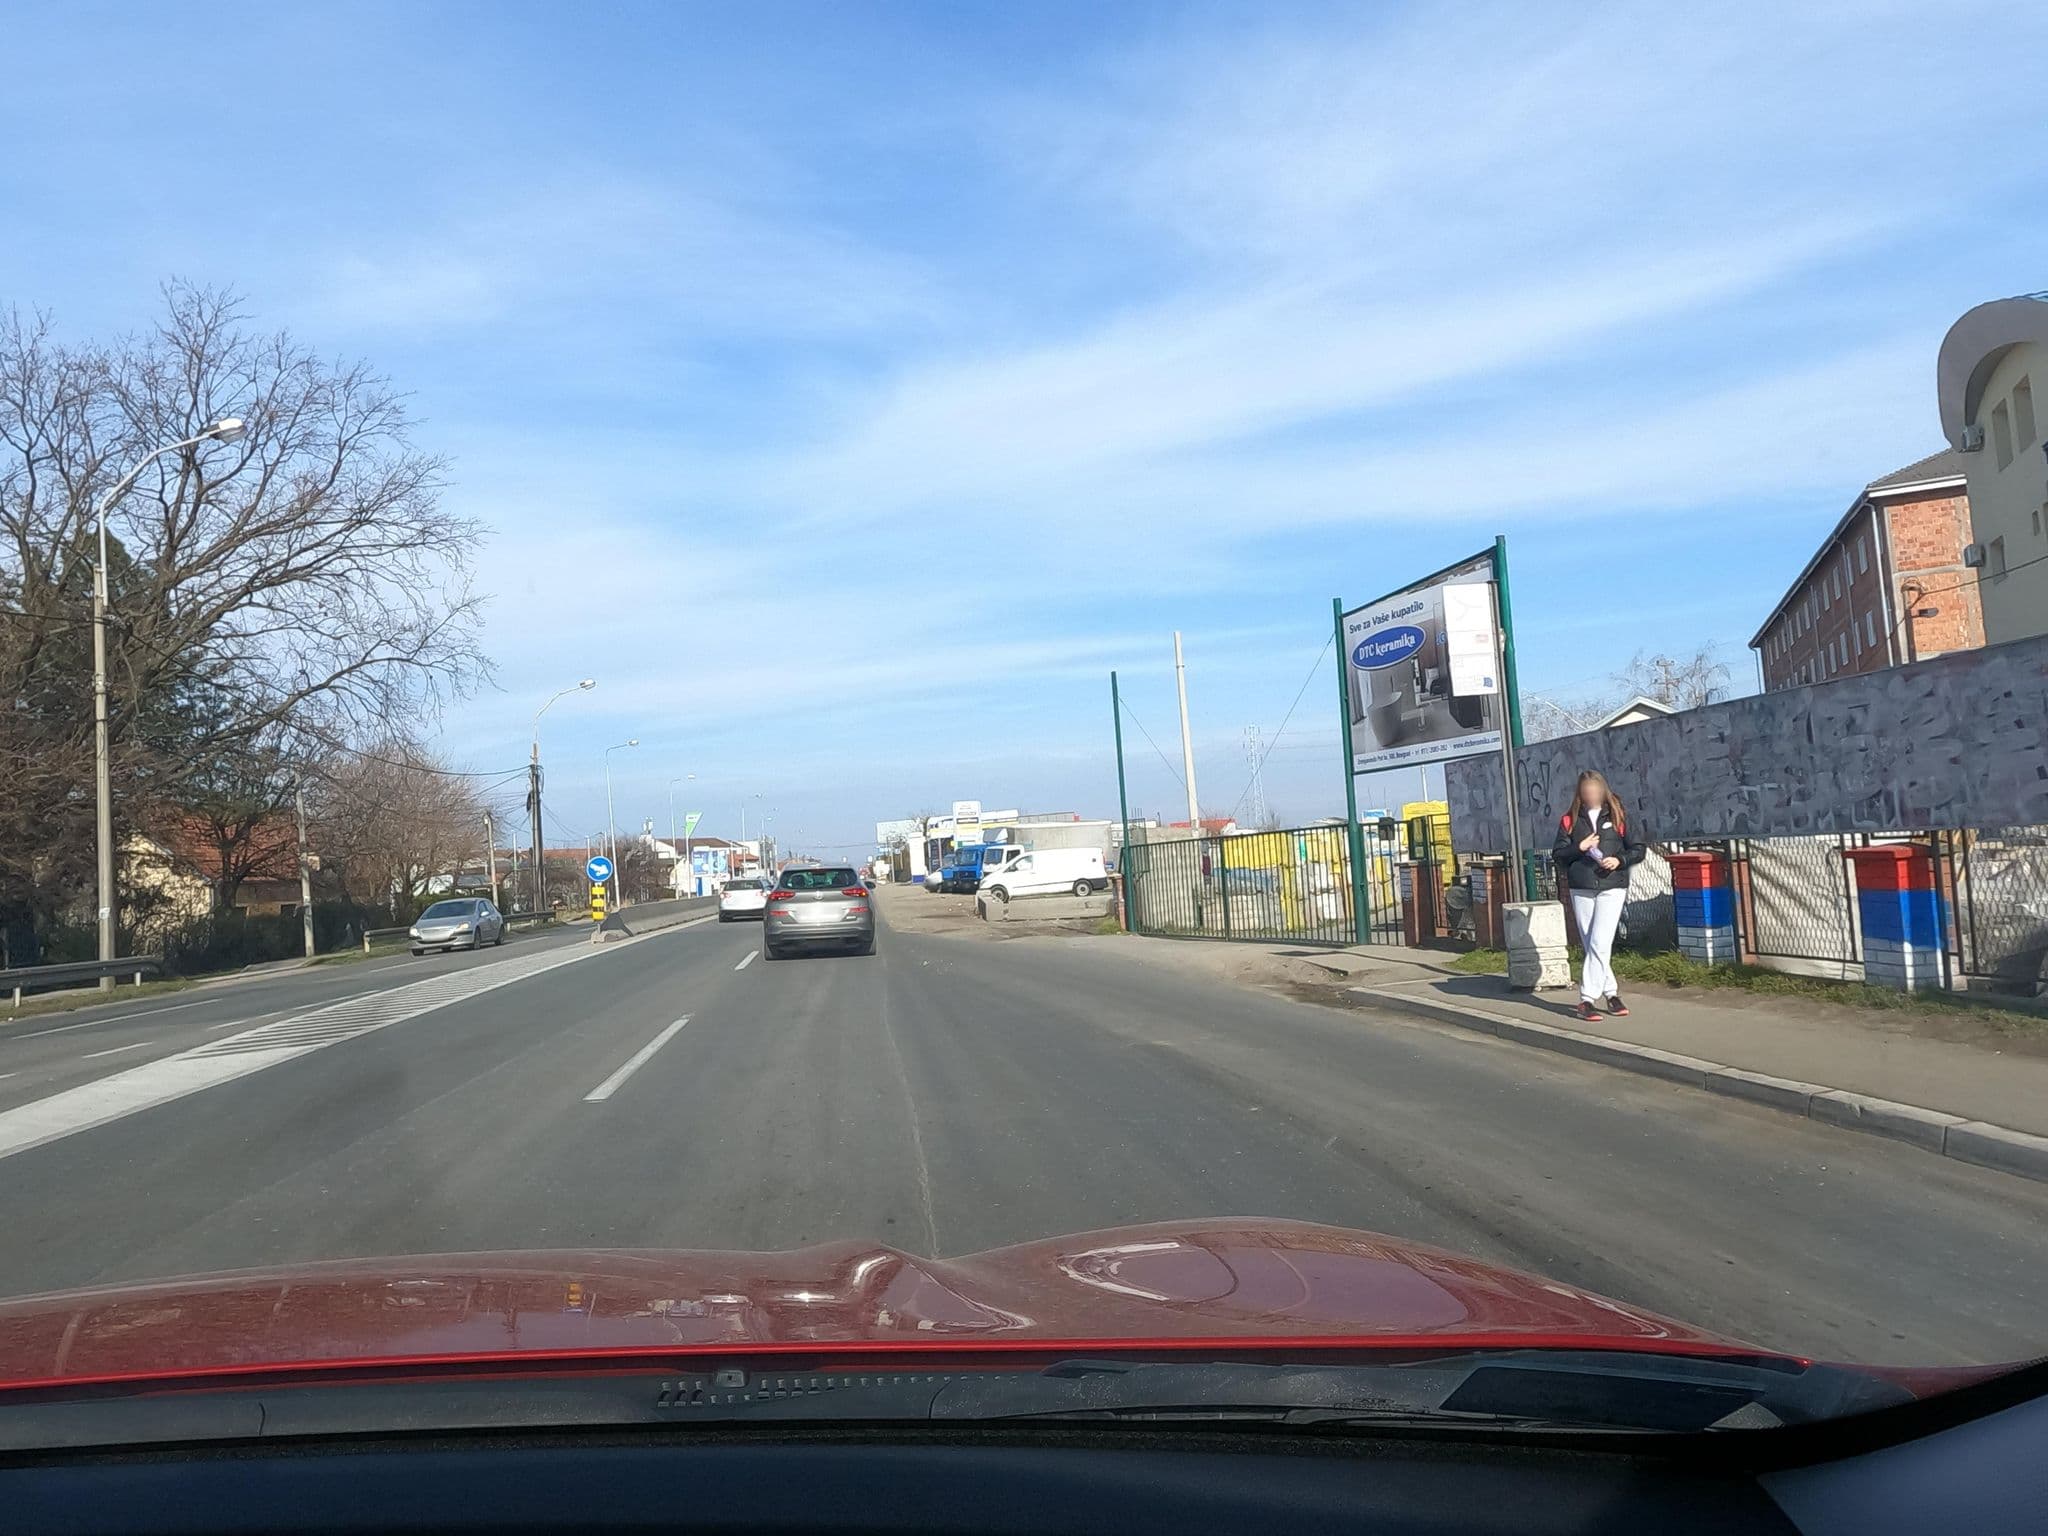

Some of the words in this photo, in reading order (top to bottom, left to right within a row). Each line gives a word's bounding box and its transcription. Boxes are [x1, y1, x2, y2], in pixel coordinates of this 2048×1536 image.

[1349, 624, 1361, 634] Sve
[1363, 620, 1371, 629] za
[1372, 613, 1390, 626] Vaše
[1391, 601, 1424, 619] kupatilo
[1359, 644, 1375, 660] DTC
[1375, 633, 1416, 657] keramika
